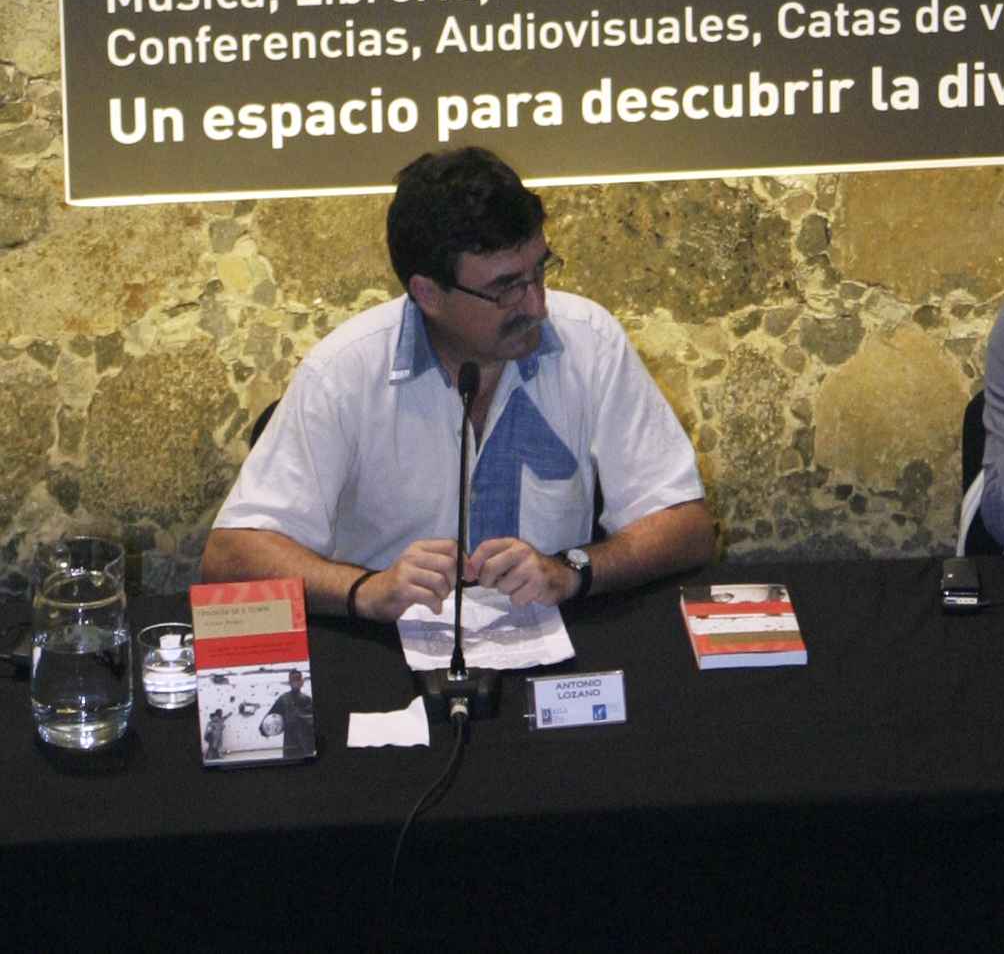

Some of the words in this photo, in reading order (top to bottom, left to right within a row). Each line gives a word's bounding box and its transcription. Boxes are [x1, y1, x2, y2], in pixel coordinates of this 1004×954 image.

[106, 19, 422, 68] Conferencias,
[435, 6, 762, 54] Audiovisuales,
[777, 1, 901, 40] Catas
[109, 97, 185, 145] Un
[202, 87, 419, 150] espacio
[437, 91, 564, 143] para
[581, 69, 855, 125] descubrir
[871, 66, 920, 112] la
[556, 679, 602, 690] ANTONIO
[557, 689, 601, 700] LOZANO
